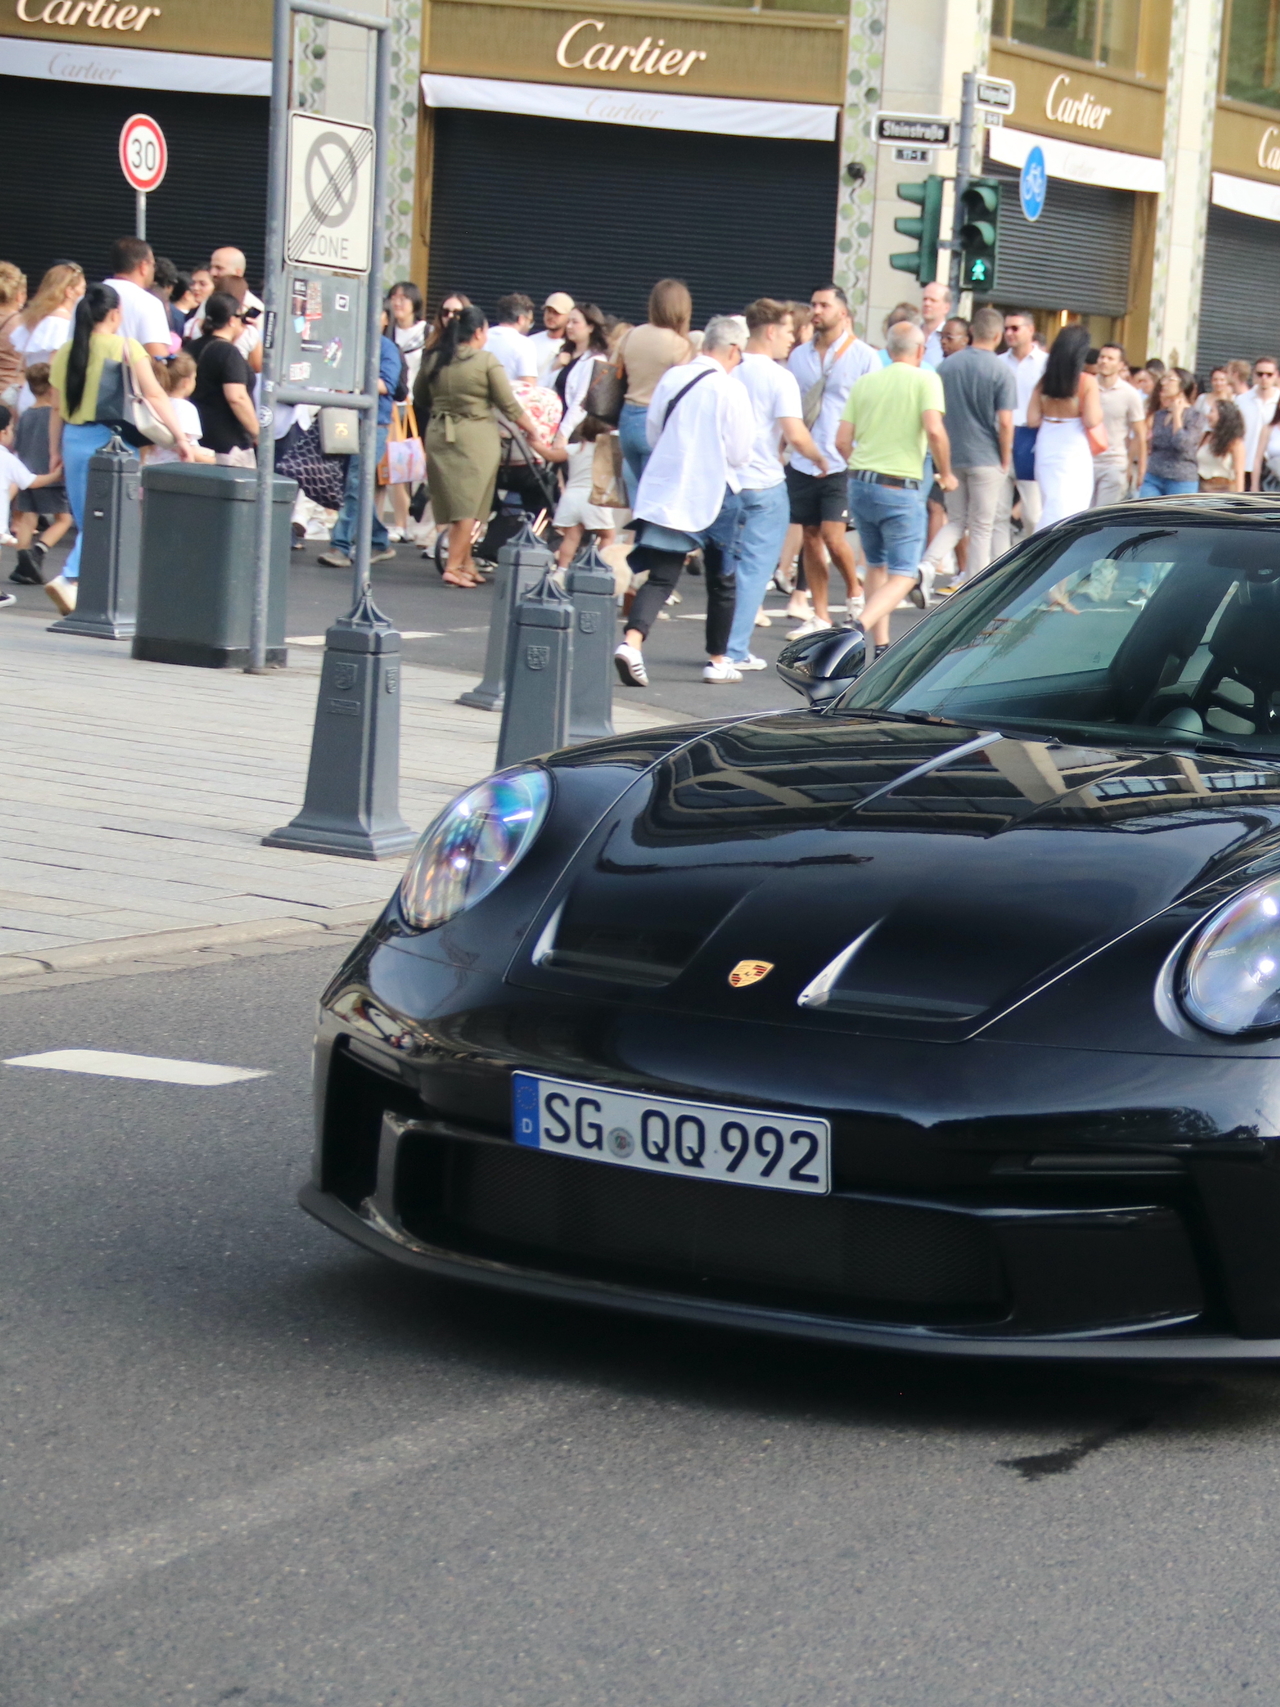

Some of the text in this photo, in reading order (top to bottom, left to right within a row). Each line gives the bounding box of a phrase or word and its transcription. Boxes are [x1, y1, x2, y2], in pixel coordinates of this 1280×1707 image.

[556, 18, 707, 77] Cartier
[47, 51, 122, 81] Cartier
[585, 93, 664, 122] Cartier
[1045, 73, 1112, 130] Cartier
[882, 120, 945, 141] Steinstraße
[131, 138, 156, 171] 30
[308, 233, 350, 260] ZONE
[521, 1118, 533, 1133] D
[543, 1091, 820, 1184] SG QQ 992
